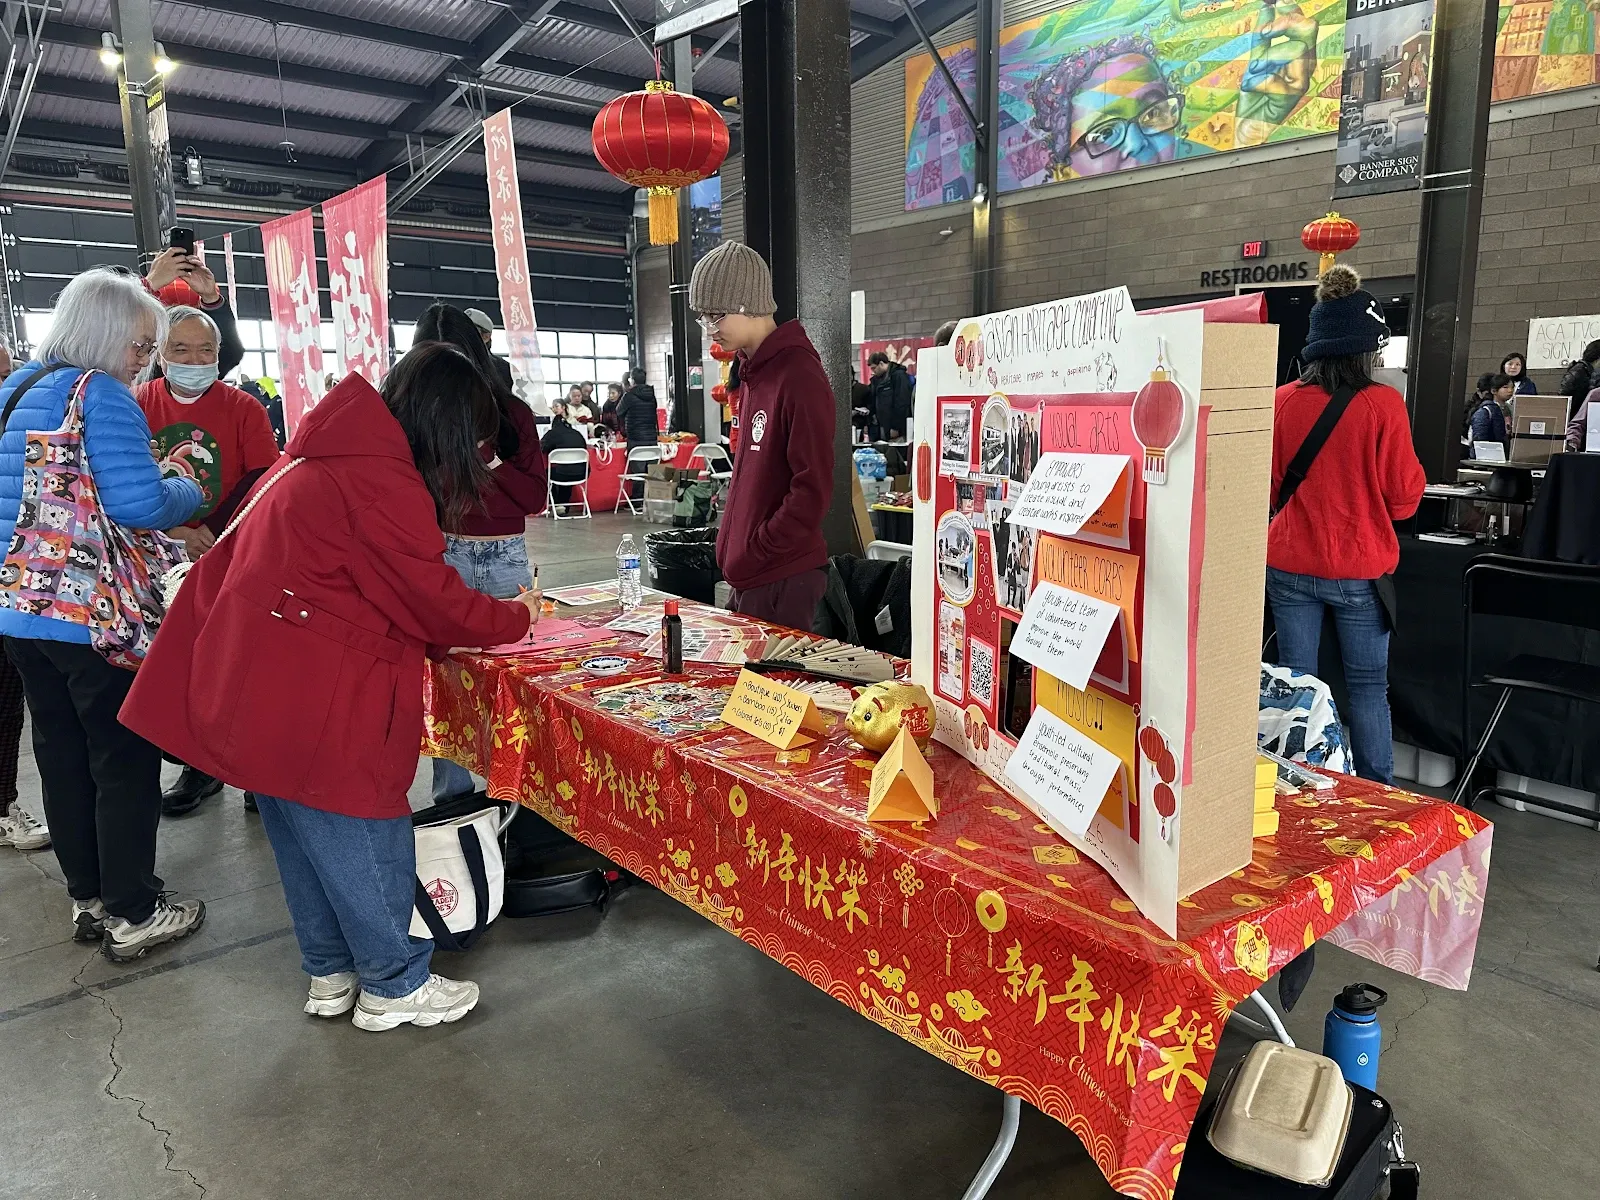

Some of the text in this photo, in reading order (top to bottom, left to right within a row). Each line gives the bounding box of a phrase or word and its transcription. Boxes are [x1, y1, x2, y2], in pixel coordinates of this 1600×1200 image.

[1358, 163, 1418, 181] COMPANY
[1360, 155, 1419, 172] BANNER SIGN
[1243, 241, 1262, 257] EXIT
[1200, 261, 1308, 288] RESTROOMS
[1536, 324, 1564, 341] ACA
[1543, 342, 1571, 360] SIGN
[1051, 479, 1075, 492] artists
[1079, 482, 1090, 493] to
[1068, 497, 1085, 510] and
[1036, 608, 1087, 632] of volunteers to
[1079, 603, 1099, 618] team
[1030, 620, 1083, 650] improve the world
[1047, 643, 1065, 657] them
[1033, 739, 1090, 783] ensemble preserving
[1067, 743, 1094, 765] cultural
[1029, 749, 1082, 793] traditional music
[580, 744, 666, 829] 新年快樂
[1022, 760, 1045, 785] through
[1049, 781, 1085, 813] performances
[607, 812, 632, 833] Chinese
[742, 820, 869, 934] 新年快樂
[435, 896, 454, 905] ADER
[780, 907, 812, 937] Chinese
[995, 938, 1217, 1102] 新年快樂
[1039, 1045, 1066, 1065] Happy
[1069, 1055, 1106, 1101] Chinese
[1119, 1109, 1134, 1127] Year
